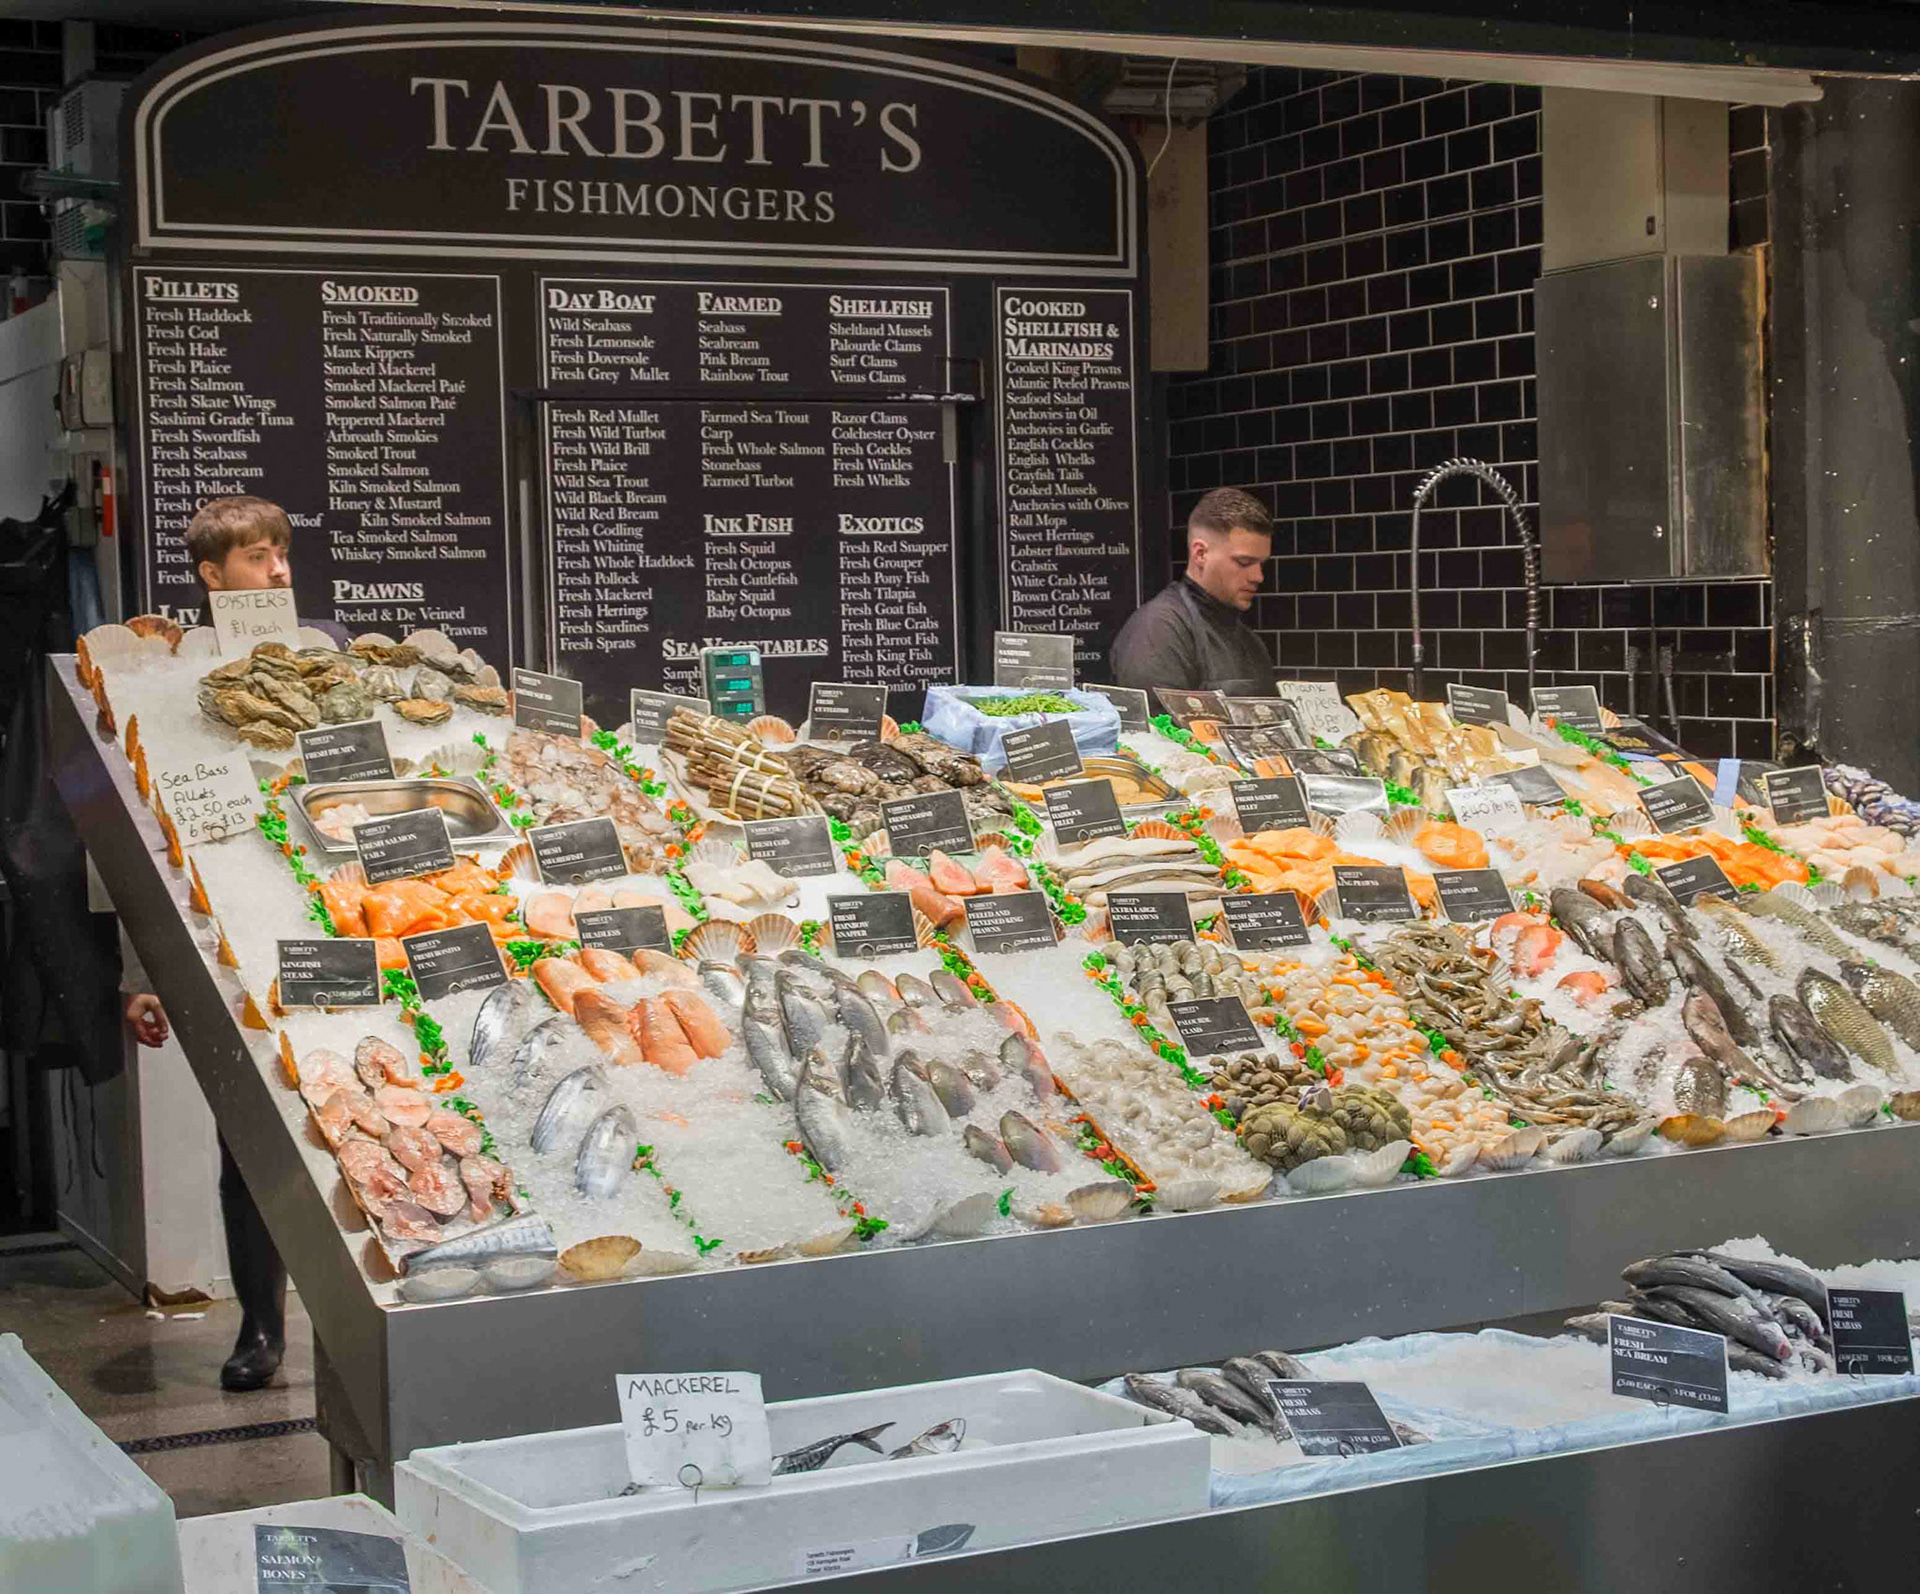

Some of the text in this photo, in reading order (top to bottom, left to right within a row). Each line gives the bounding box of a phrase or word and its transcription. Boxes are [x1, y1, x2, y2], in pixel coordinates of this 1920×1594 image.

[410, 76, 921, 172] TARBETT'S
[505, 177, 836, 222] FISHMONGERS
[144, 276, 239, 298] FILLETS
[322, 281, 419, 302] SMOKED
[548, 289, 656, 310] DAY BOAT
[698, 292, 782, 312] FARMED
[830, 295, 932, 316] SHELLFISH
[1005, 297, 1085, 316] COOKED
[146, 307, 252, 322] Fresh Haddock
[147, 325, 219, 339] Fresh Cod
[549, 318, 632, 331] Wild Seabass
[698, 321, 745, 333] Seabass
[1005, 318, 1119, 338] SHELLFISH &
[323, 328, 471, 345] Fresh Naturally Smoked
[550, 334, 583, 347] Fresh
[699, 337, 759, 349] Seabream
[324, 345, 414, 361] Manx Kippers
[830, 339, 921, 352] Palourde Clams
[1006, 339, 1113, 357] MARINADES
[148, 359, 232, 374] Fresh Plaice
[700, 352, 770, 366] Pink Bream
[551, 367, 669, 384] Fresh Grey Mullet
[701, 369, 788, 382] Rainbow Trout
[1006, 362, 1121, 376] Cooked King Prawns
[150, 377, 244, 391] Fresh Salmon
[324, 379, 375, 392] Smoked
[379, 379, 435, 392] Mackerel
[150, 394, 277, 411] Fresh Skate Wings
[1007, 393, 1084, 405] Seafood Salad
[150, 412, 294, 425] Sashimi Grade Tuna
[326, 412, 444, 429] Peppered Mackerel
[832, 412, 908, 424] Razor Clams
[152, 430, 260, 442] Fresh Swordfish
[326, 430, 438, 443] Arbroath Smokies
[701, 427, 733, 443] Carp
[554, 475, 648, 488] Wild Sea Trout
[330, 497, 441, 512] Honey & Mustard
[555, 491, 666, 503] Wild Black Bream
[704, 514, 793, 532] INK FISH
[838, 514, 924, 532] EXOTICS
[1010, 514, 1067, 528] Roll Mops
[839, 541, 948, 555] Fresh Red Snapper
[1011, 560, 1058, 572] Crabstix
[706, 573, 798, 586] Fresh Cuttlefish
[332, 580, 423, 599] PRAWNS
[706, 589, 775, 605] Baby Squid
[841, 588, 916, 602] Fresh Tilapia
[216, 592, 288, 609] OYSTERS
[1013, 605, 1091, 618] Dressed Crabs
[252, 622, 283, 637] each
[161, 764, 228, 789] Sea Bass
[174, 795, 252, 825] £2.50 each
[1832, 1310, 1853, 1318] FRESH
[1614, 1338, 1644, 1349] FRESH
[1614, 1349, 1667, 1364] SEA BREAM
[629, 1376, 740, 1399] MACKEREL
[642, 1407, 679, 1437] £5
[686, 1421, 704, 1434] per
[261, 1555, 316, 1565] SALMON
[262, 1569, 306, 1579] BONES
